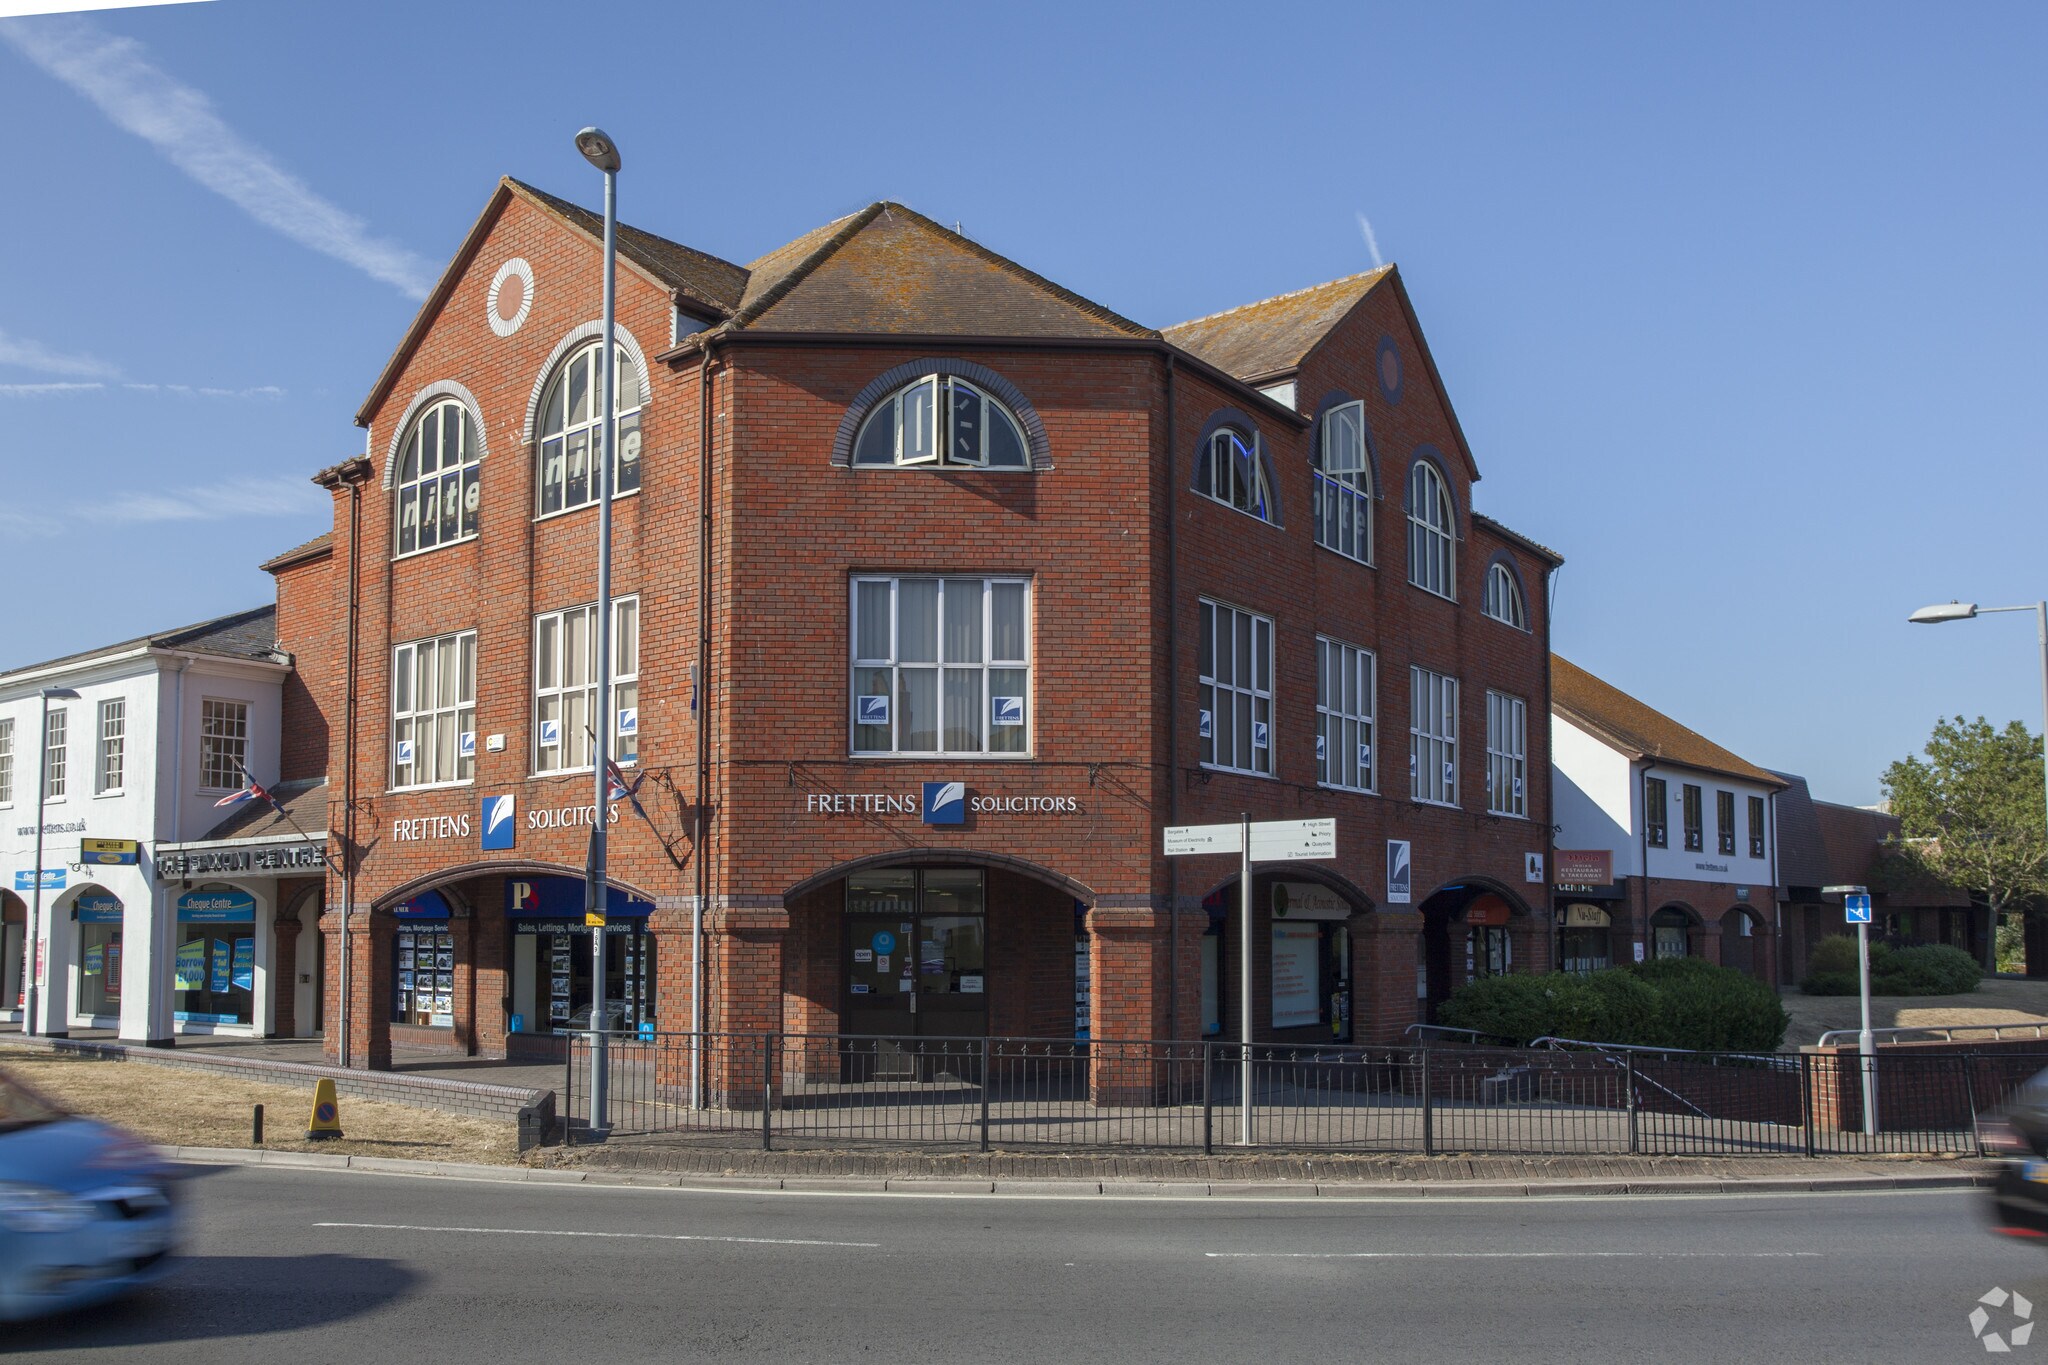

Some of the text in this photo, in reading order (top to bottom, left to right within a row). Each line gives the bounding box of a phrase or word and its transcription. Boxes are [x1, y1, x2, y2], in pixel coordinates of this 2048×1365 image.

[545, 430, 641, 486] nie
[403, 481, 479, 528] nite
[807, 794, 1077, 813] FRETTENS SOLICITORS
[394, 814, 470, 841] FRETTENS
[157, 846, 326, 872] THE SAXON CENTRE
[1559, 884, 1593, 892] CENTRE
[93, 901, 113, 913] Cheque
[187, 898, 232, 911] Cheque Centre
[518, 923, 537, 933] Sales,
[538, 923, 566, 933] Lettings,
[606, 923, 631, 932] ervices
[176, 956, 205, 968] Borrow
[178, 969, 206, 984] £1,000
